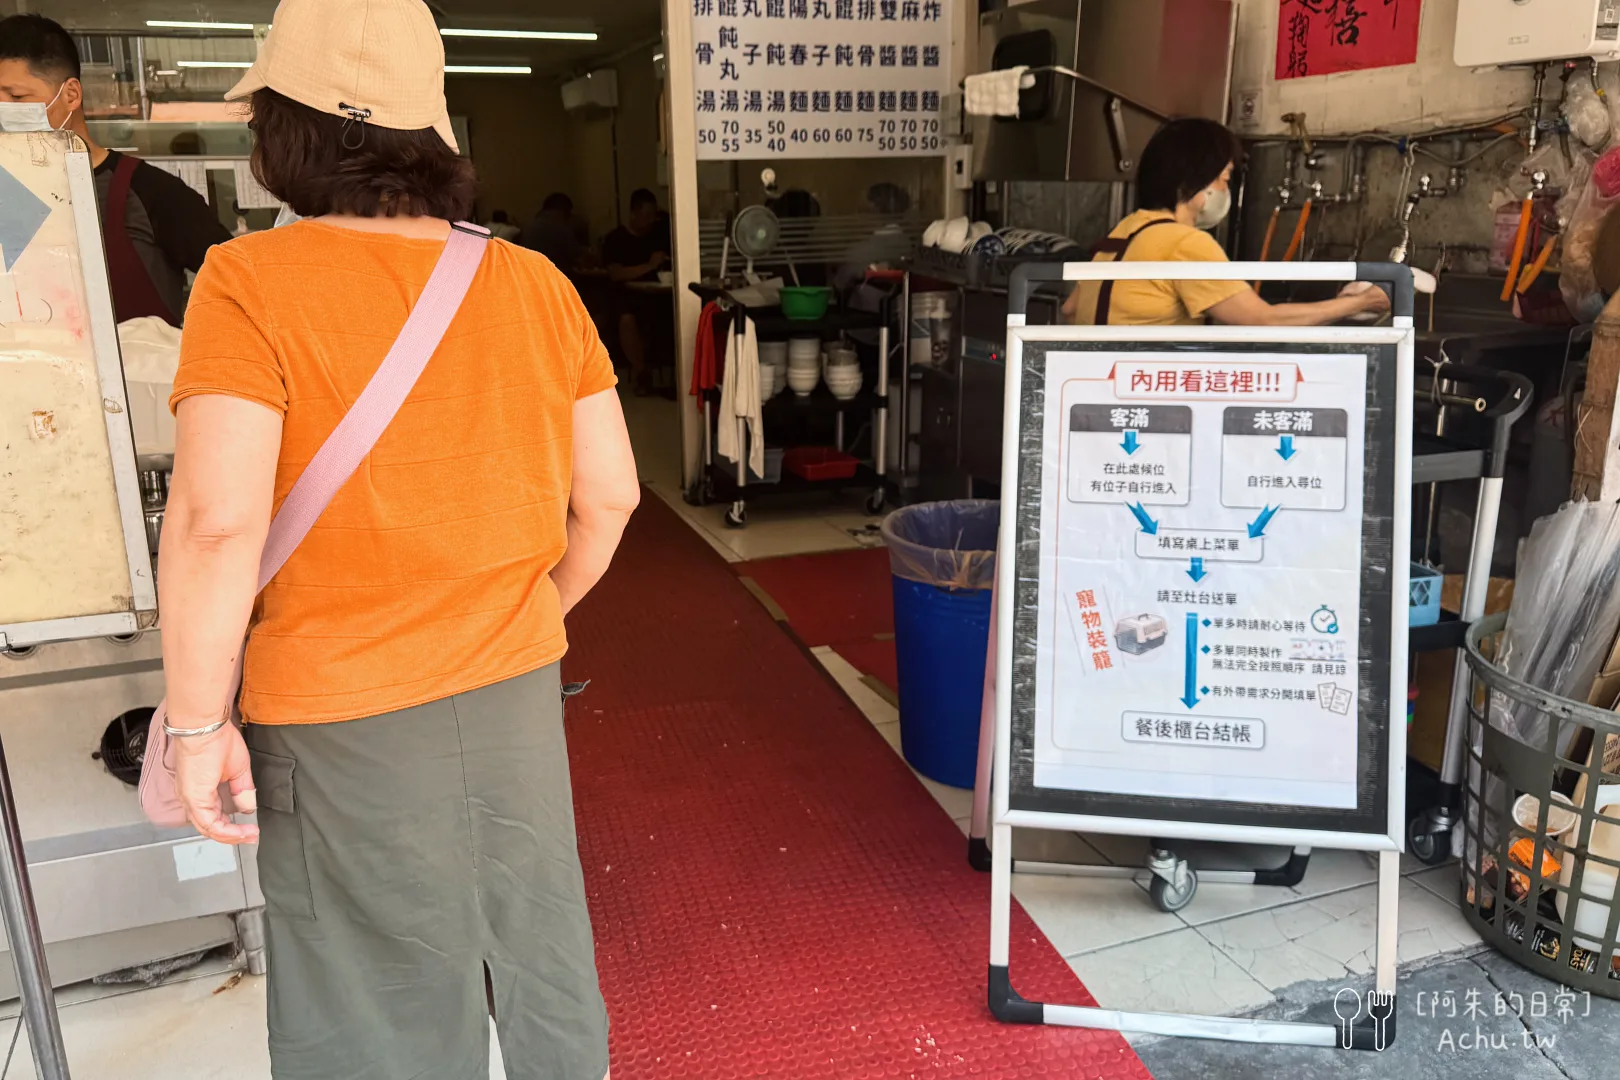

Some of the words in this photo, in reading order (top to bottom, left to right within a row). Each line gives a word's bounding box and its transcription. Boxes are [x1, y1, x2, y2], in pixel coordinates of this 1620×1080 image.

[721, 120, 740, 134] 70
[767, 120, 785, 134] 50
[879, 119, 896, 133] 70
[900, 119, 917, 133] 70
[921, 119, 939, 133] 70
[698, 129, 716, 143] 50
[744, 129, 762, 143] 35
[790, 129, 808, 142] 40
[812, 128, 830, 142] 60
[835, 128, 853, 142] 60
[858, 128, 874, 142] 75
[721, 138, 740, 152] 55
[767, 138, 786, 152] 40
[878, 136, 896, 150] 50
[899, 136, 917, 150] 50
[921, 136, 939, 150] 50
[1131, 370, 1280, 393] 內用看這裡!!!
[1110, 407, 1150, 428] 客滿
[1253, 410, 1314, 431] 未客滿
[1103, 462, 1165, 477] 在此處候位
[1090, 480, 1177, 495] 有位子自行進入
[1247, 475, 1322, 489] 自行進入尋位
[1158, 536, 1239, 551] 填寫桌上菜單
[1157, 590, 1237, 605] 請至灶台送單
[1076, 589, 1113, 671] 寵物裝籠
[1213, 617, 1306, 632] 單多時請耐心等待
[1213, 644, 1282, 658] 多單同時製作
[1212, 658, 1305, 674] 無法完全按照順序
[1312, 664, 1346, 675] 請見諒
[1212, 685, 1316, 701] 有外帶需求分開填單
[1136, 717, 1251, 743] 餐後櫃台結帳
